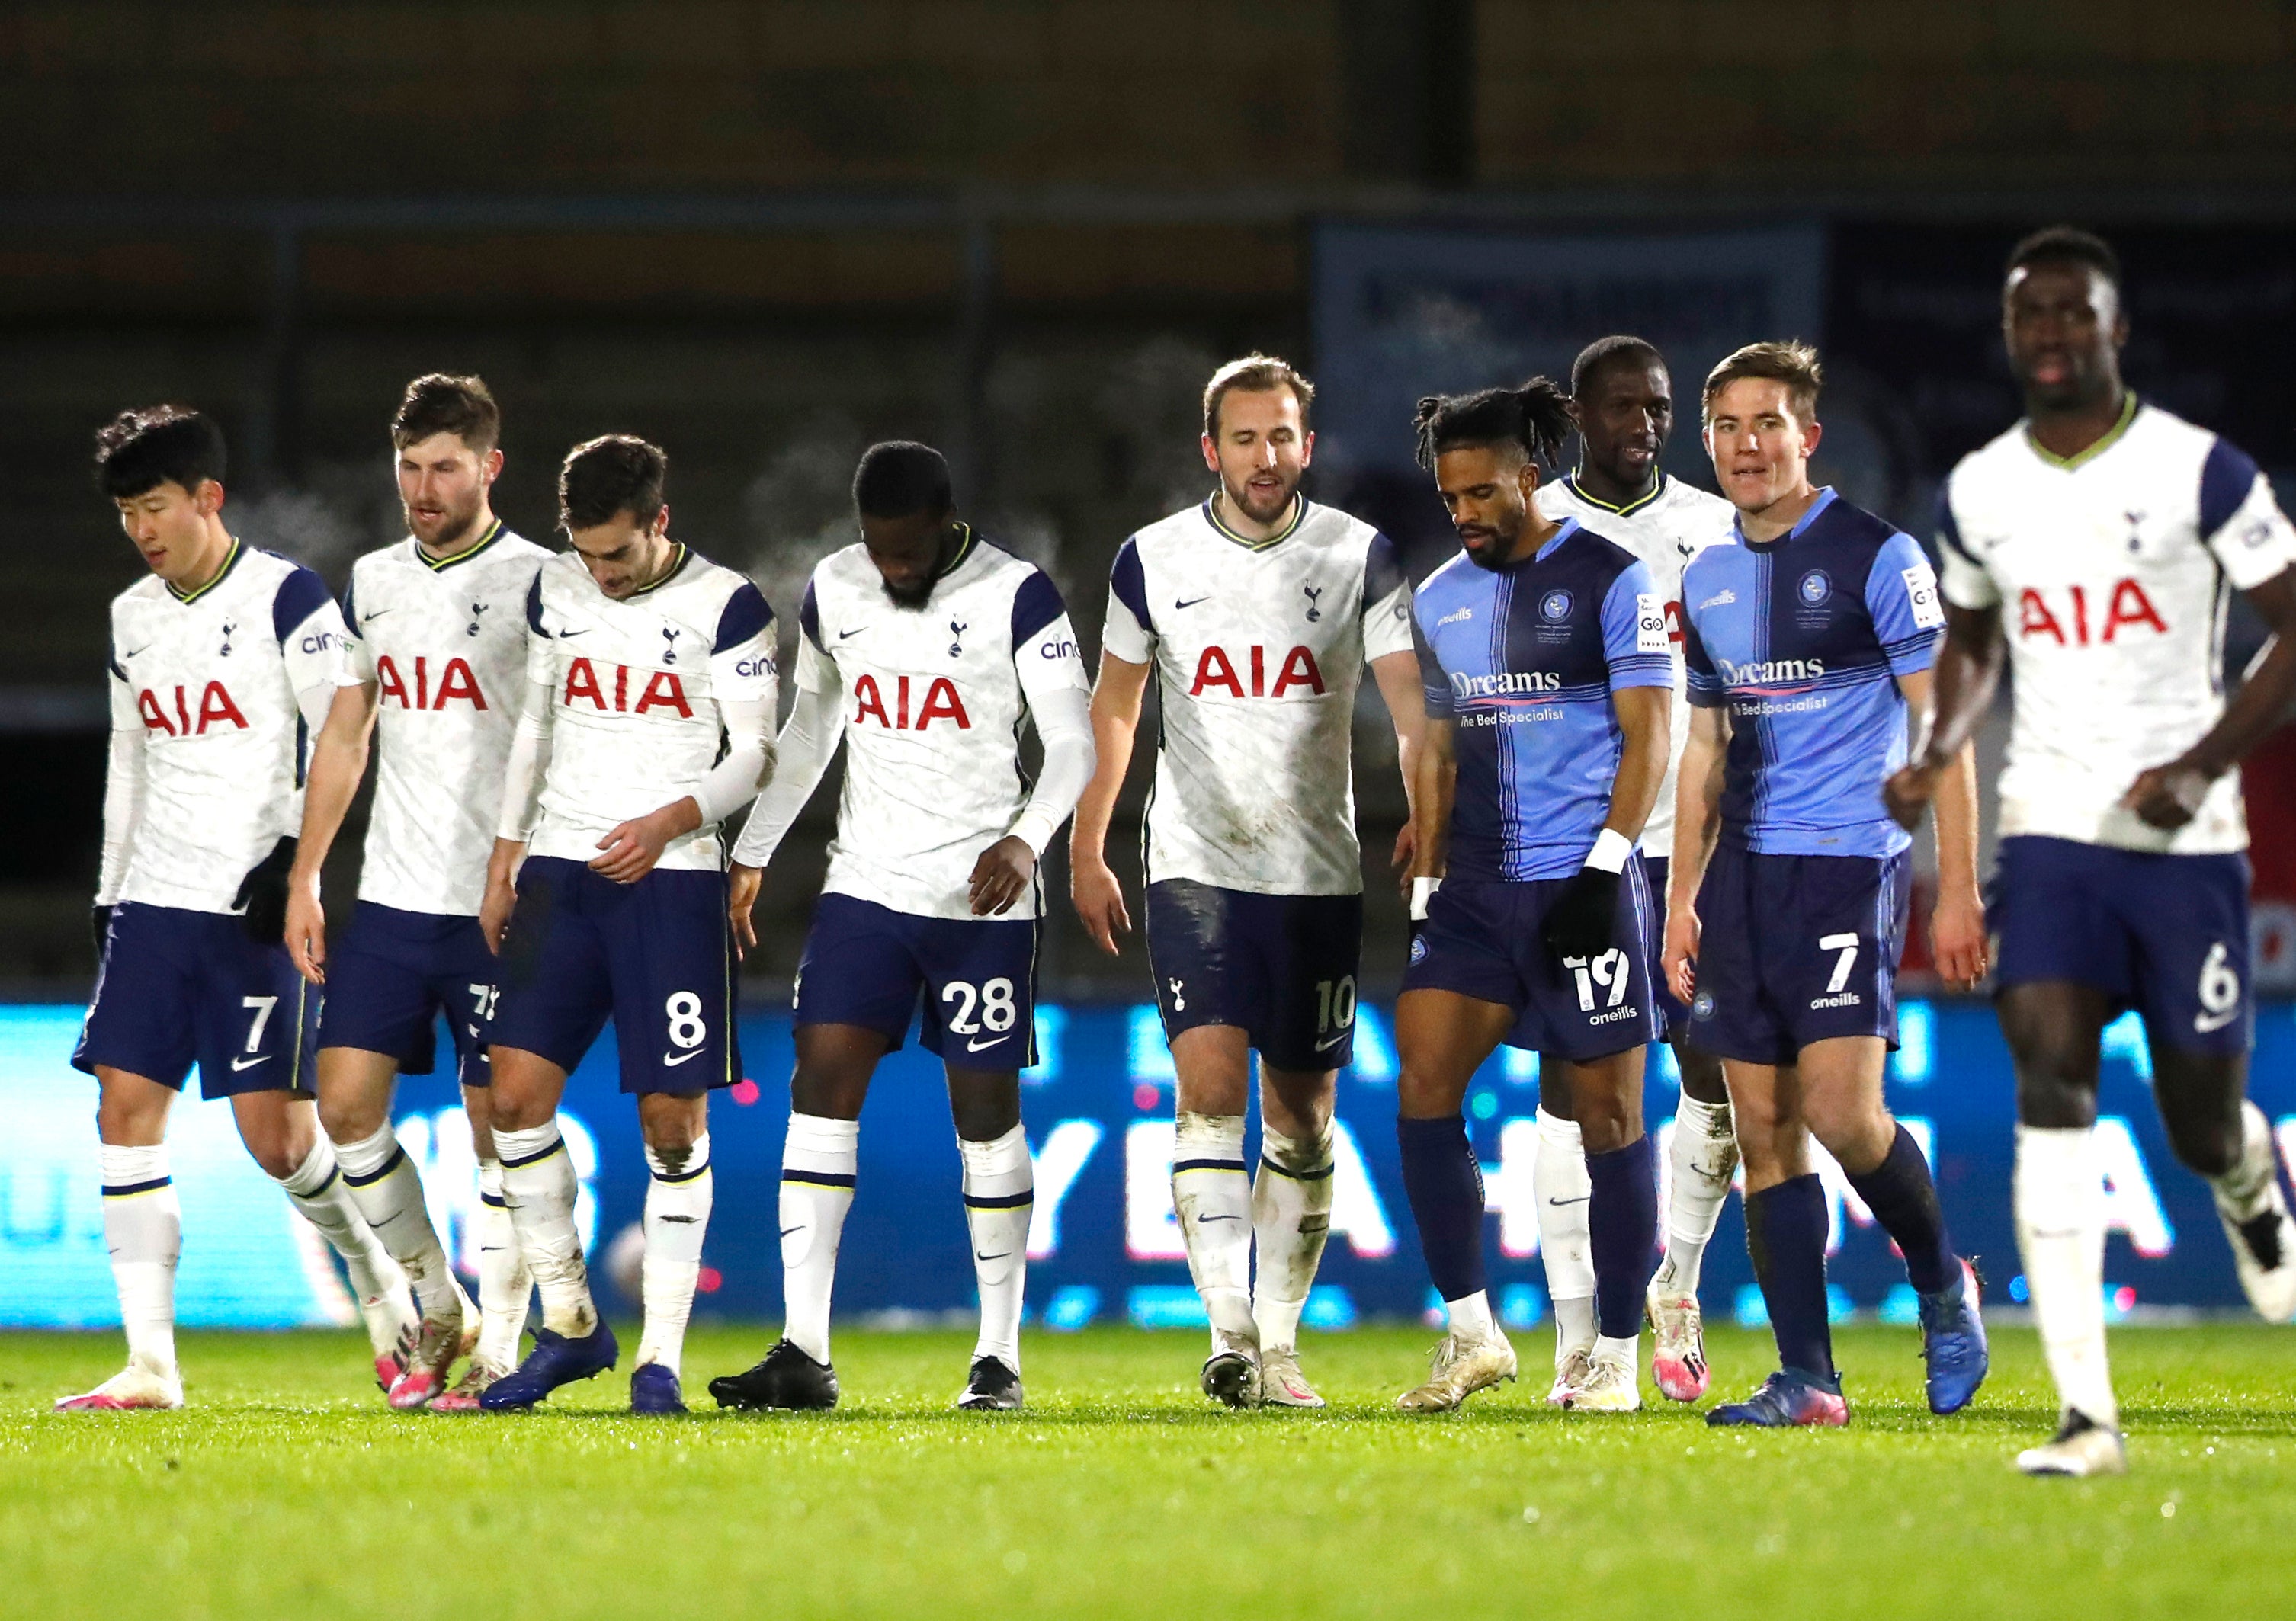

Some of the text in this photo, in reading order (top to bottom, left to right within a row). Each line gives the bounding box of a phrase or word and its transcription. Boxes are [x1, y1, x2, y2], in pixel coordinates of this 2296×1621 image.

[1640, 617, 1664, 631] GO
[2020, 577, 2169, 647] AIA
[377, 654, 488, 711] AIA
[564, 656, 694, 719] AIA
[1189, 644, 1326, 699] AIA
[1451, 671, 1560, 698] Dreams
[138, 680, 249, 737] AIA
[854, 674, 971, 731] AIA
[1477, 712, 1497, 726] Bed
[1499, 708, 1563, 727] Specialist
[1563, 947, 1630, 1012] 19
[1818, 932, 1860, 993] 7
[2198, 942, 2240, 1012] 6
[242, 995, 279, 1053] 7
[665, 991, 707, 1049] 8
[941, 977, 1016, 1035] 28
[1315, 975, 1356, 1033] 10
